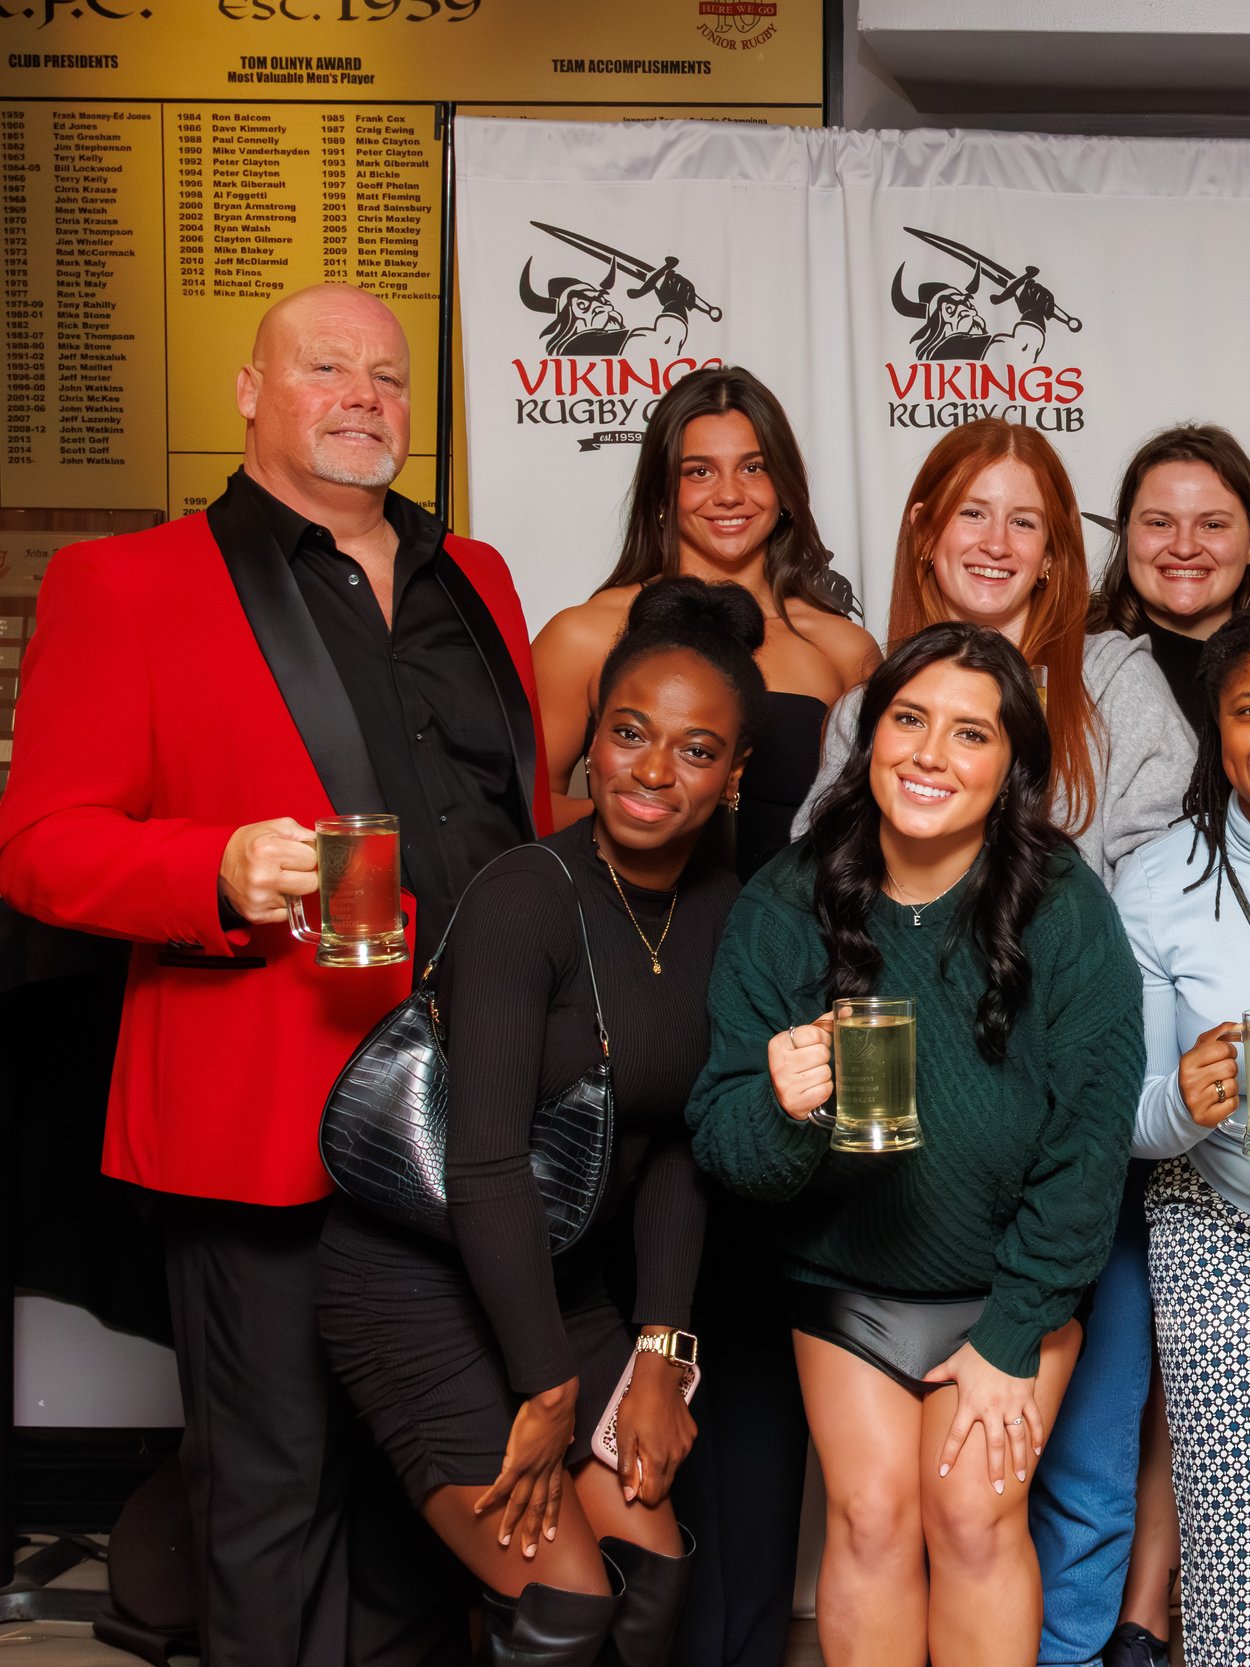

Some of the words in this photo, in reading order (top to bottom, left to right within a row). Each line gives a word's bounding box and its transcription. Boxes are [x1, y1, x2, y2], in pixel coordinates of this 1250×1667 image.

[702, 4, 733, 14] HERE
[737, 5, 754, 13] WE
[758, 6, 774, 15] GO
[696, 23, 737, 50] JUNIOR
[741, 22, 778, 50] RUGBY
[8, 54, 41, 68] CLUB
[43, 55, 119, 69] PRESIDENTS
[240, 55, 267, 70] TOM
[270, 56, 313, 71] OLINYK
[315, 57, 362, 71] AWARD
[551, 59, 586, 74] TEAM
[588, 60, 712, 75] ACCOMPLISHMENTS
[227, 71, 254, 83] Most
[255, 72, 304, 84] Valuable
[306, 72, 339, 84] Men's
[340, 73, 375, 85] Player
[356, 126, 382, 136] Craig
[385, 126, 414, 136] Ewing
[382, 138, 420, 148] Clayton
[385, 149, 423, 159] Clayton
[242, 159, 280, 169] Clayton
[243, 170, 280, 180] Clayton
[382, 193, 421, 203] Fleming
[214, 203, 242, 213] Bryan
[245, 203, 296, 213] Armstrong
[214, 214, 242, 224] Bryan
[245, 214, 296, 224] Armstrong
[214, 224, 238, 234] Ryan
[214, 236, 251, 246] Clayton
[380, 238, 418, 248] Fleming
[384, 259, 418, 269] Blakey
[884, 362, 1085, 404] VIKINGS
[515, 398, 639, 426] RUGBY
[1001, 404, 1085, 432] CLUB
[599, 433, 614, 442] est.
[615, 433, 643, 442] 1959
[183, 497, 208, 505] 1999
[914, 915, 921, 926] E
